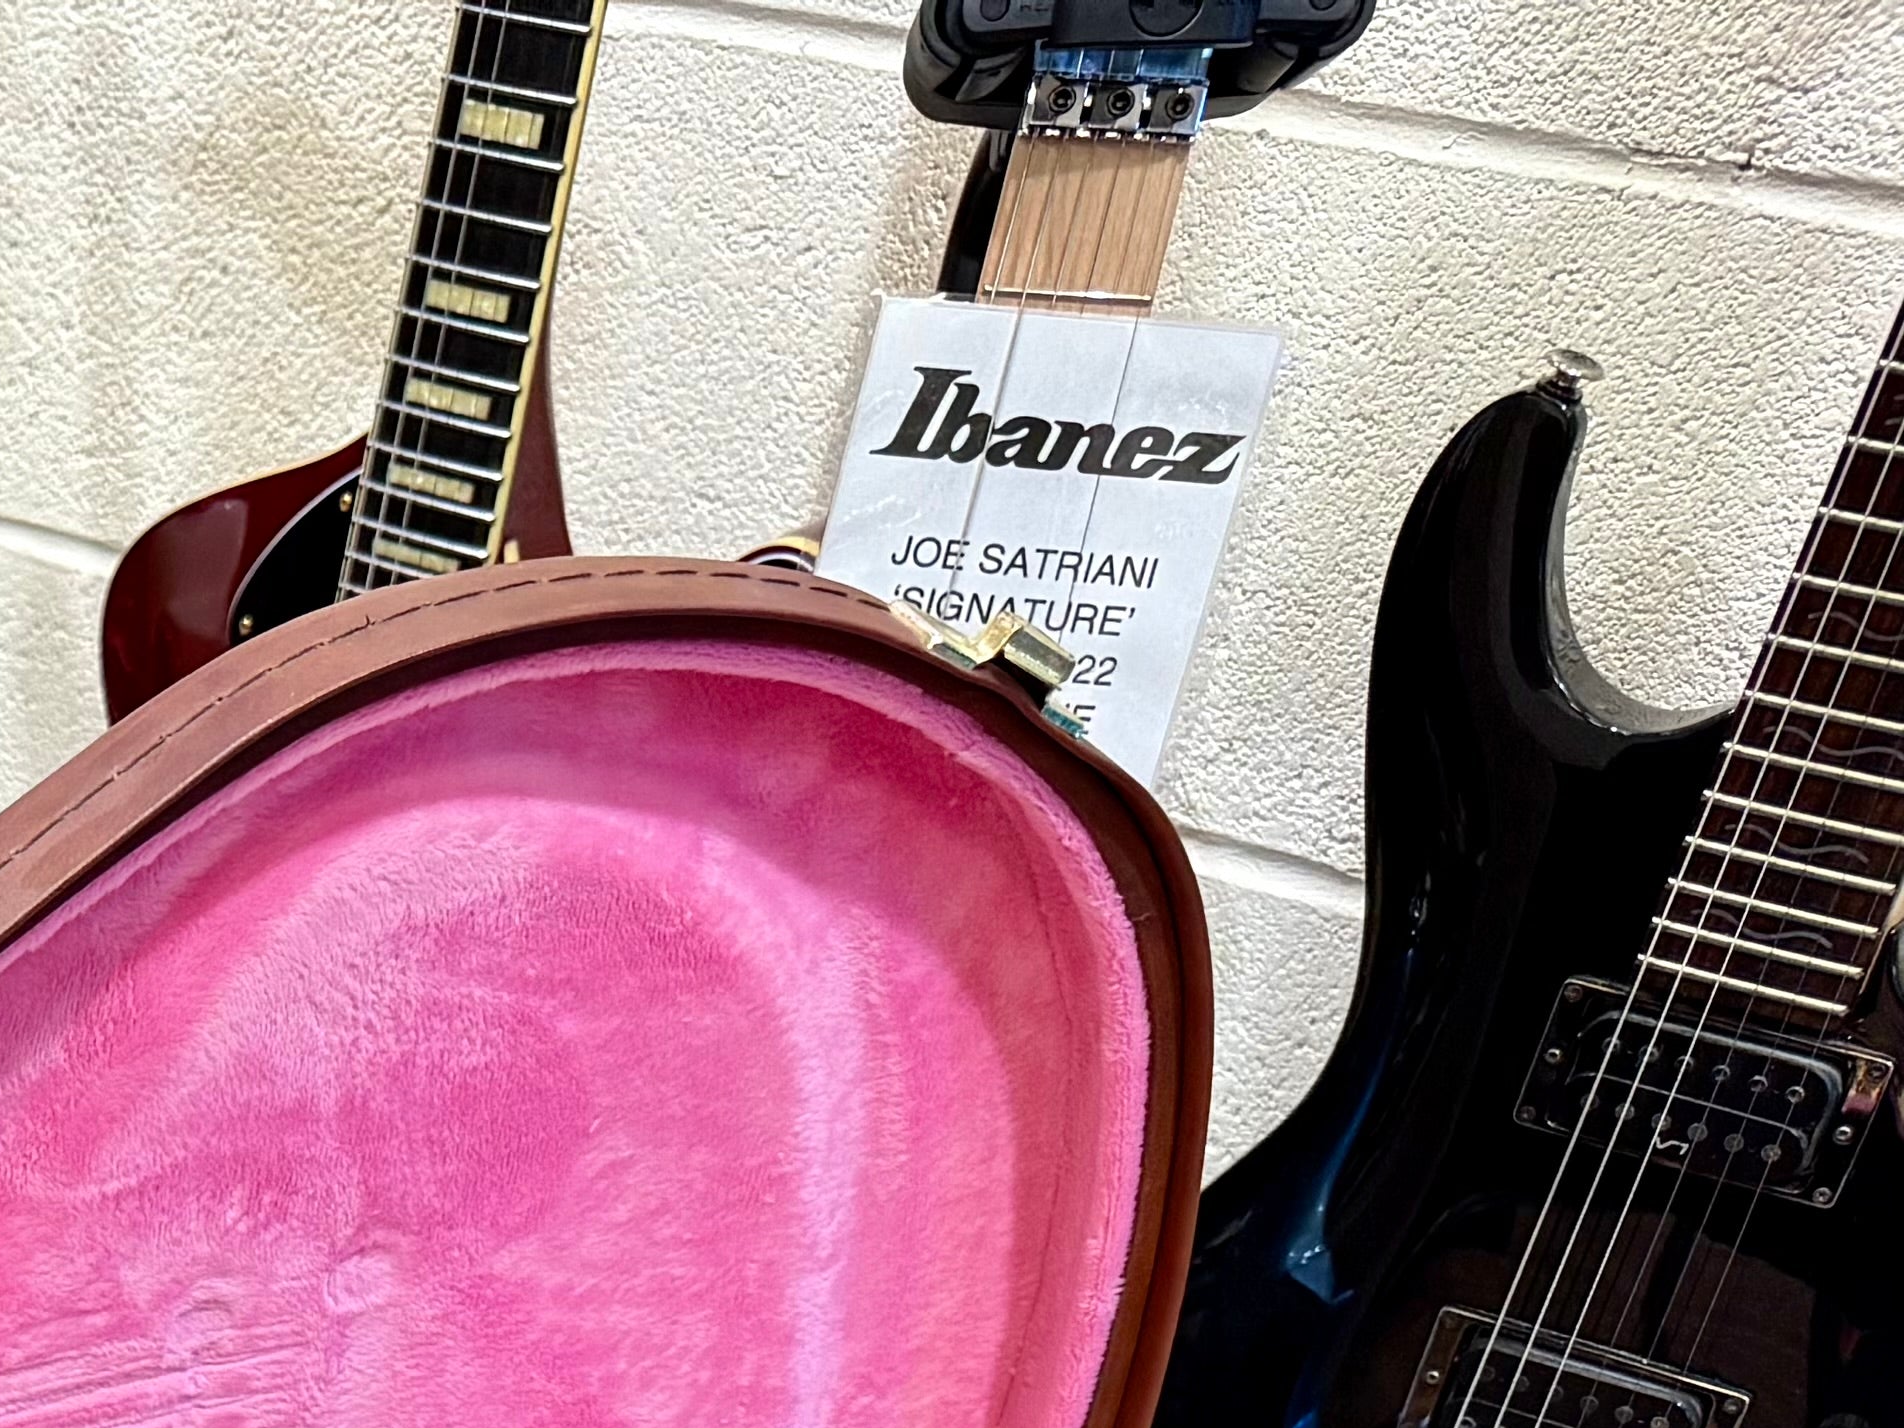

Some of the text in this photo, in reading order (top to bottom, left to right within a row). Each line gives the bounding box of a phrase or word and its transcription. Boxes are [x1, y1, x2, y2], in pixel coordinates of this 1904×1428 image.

[869, 365, 1248, 485] Ibanez
[891, 534, 1160, 590] JOE SATRIANI
